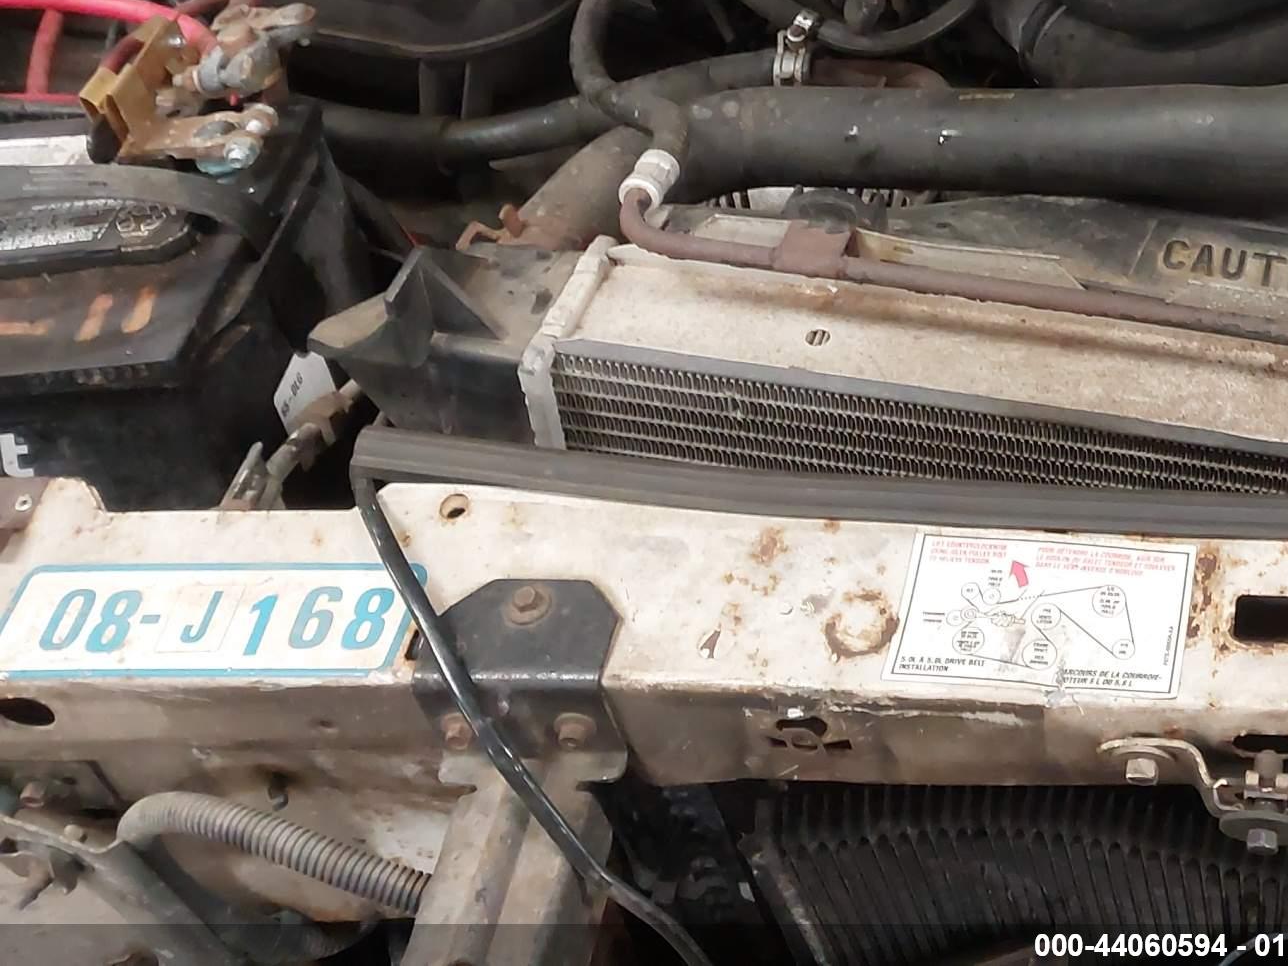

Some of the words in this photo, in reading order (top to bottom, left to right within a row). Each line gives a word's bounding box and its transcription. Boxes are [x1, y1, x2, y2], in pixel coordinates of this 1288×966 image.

[944, 657, 967, 666] DRIVE
[968, 658, 985, 667] BELT
[898, 663, 950, 672] INSTALLATION
